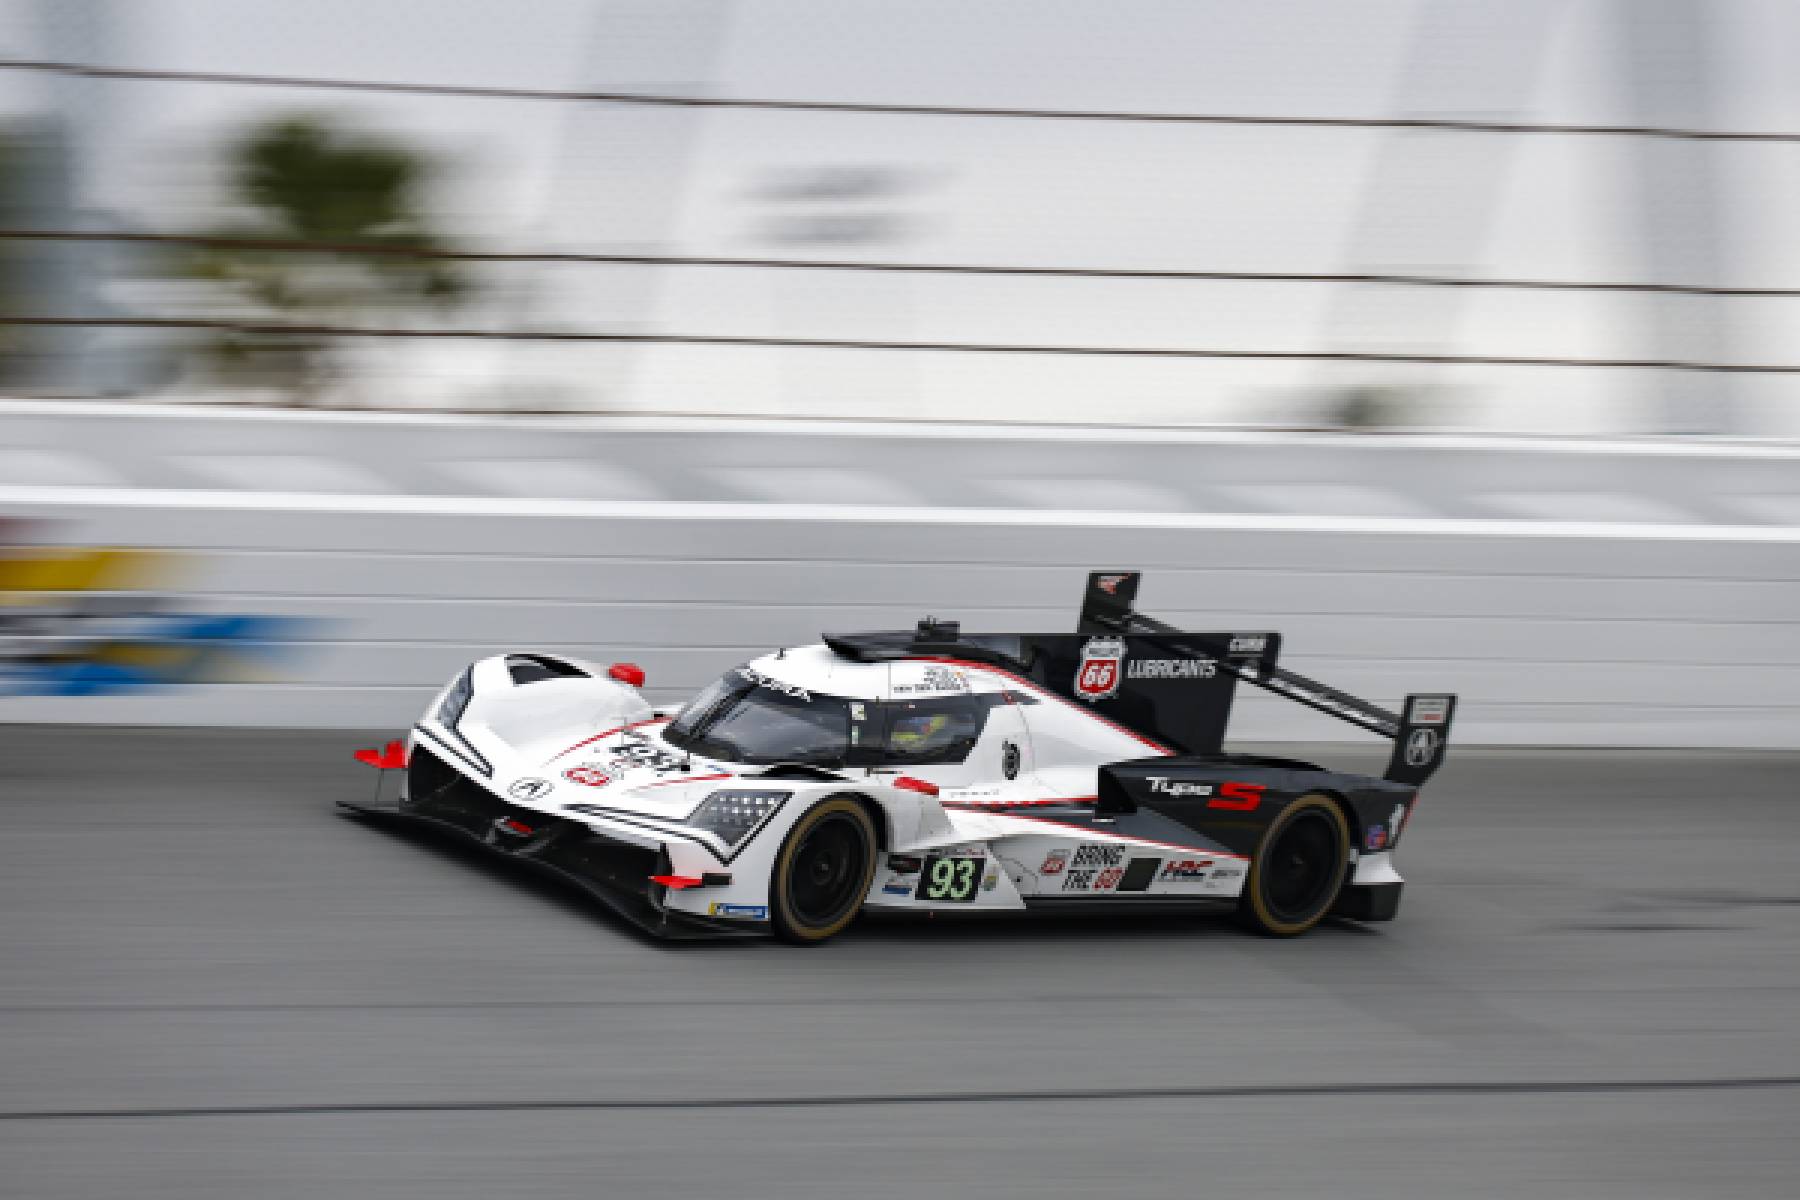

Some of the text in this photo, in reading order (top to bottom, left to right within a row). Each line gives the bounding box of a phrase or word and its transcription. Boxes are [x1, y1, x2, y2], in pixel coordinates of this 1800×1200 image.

[1083, 663, 1114, 687] 66
[1127, 659, 1217, 679] LUBRICANTS
[1144, 775, 1267, 812] Type S
[1072, 844, 1126, 866] BRING
[927, 857, 976, 898] 93
[1062, 869, 1096, 890] THE
